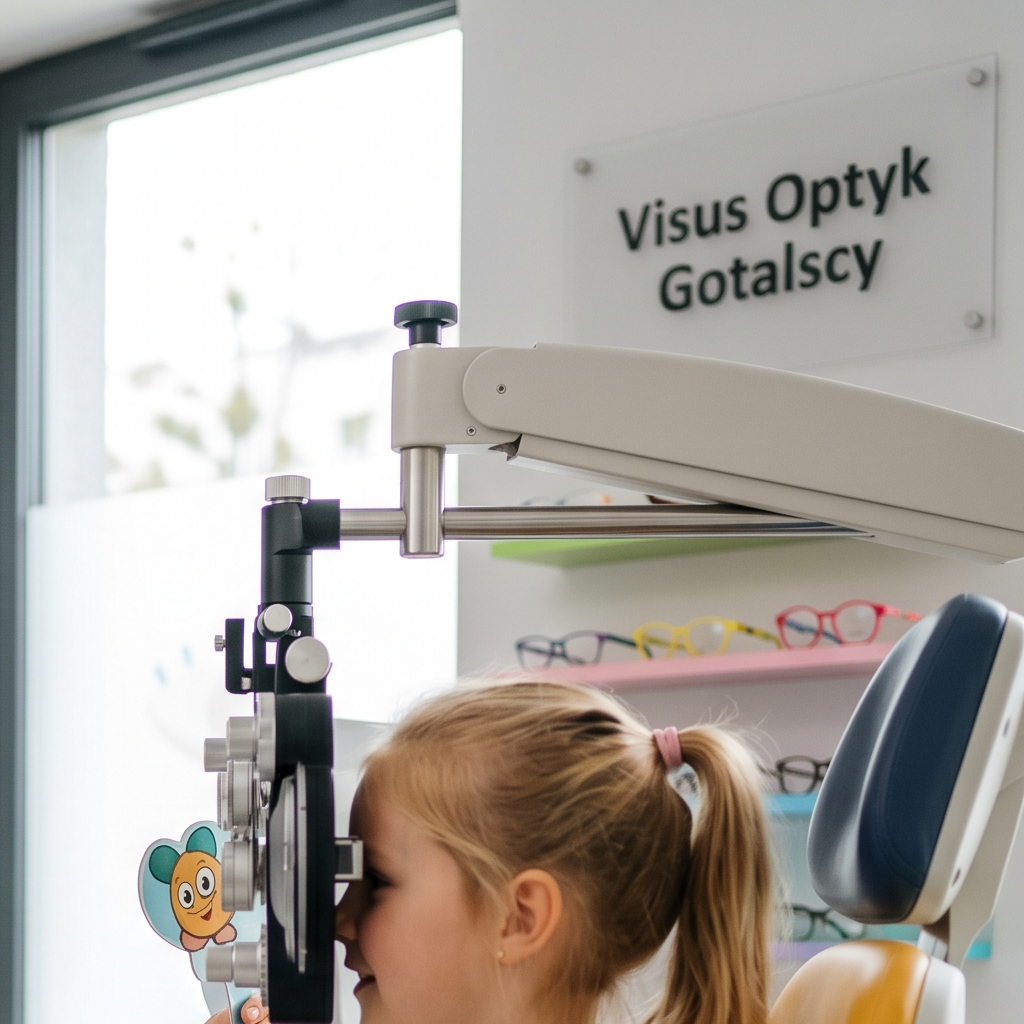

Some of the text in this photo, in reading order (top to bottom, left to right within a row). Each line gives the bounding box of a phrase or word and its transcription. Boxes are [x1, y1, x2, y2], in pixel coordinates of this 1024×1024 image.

[618, 146, 931, 250] Visus Optyk
[660, 239, 883, 311] Gotalscy
